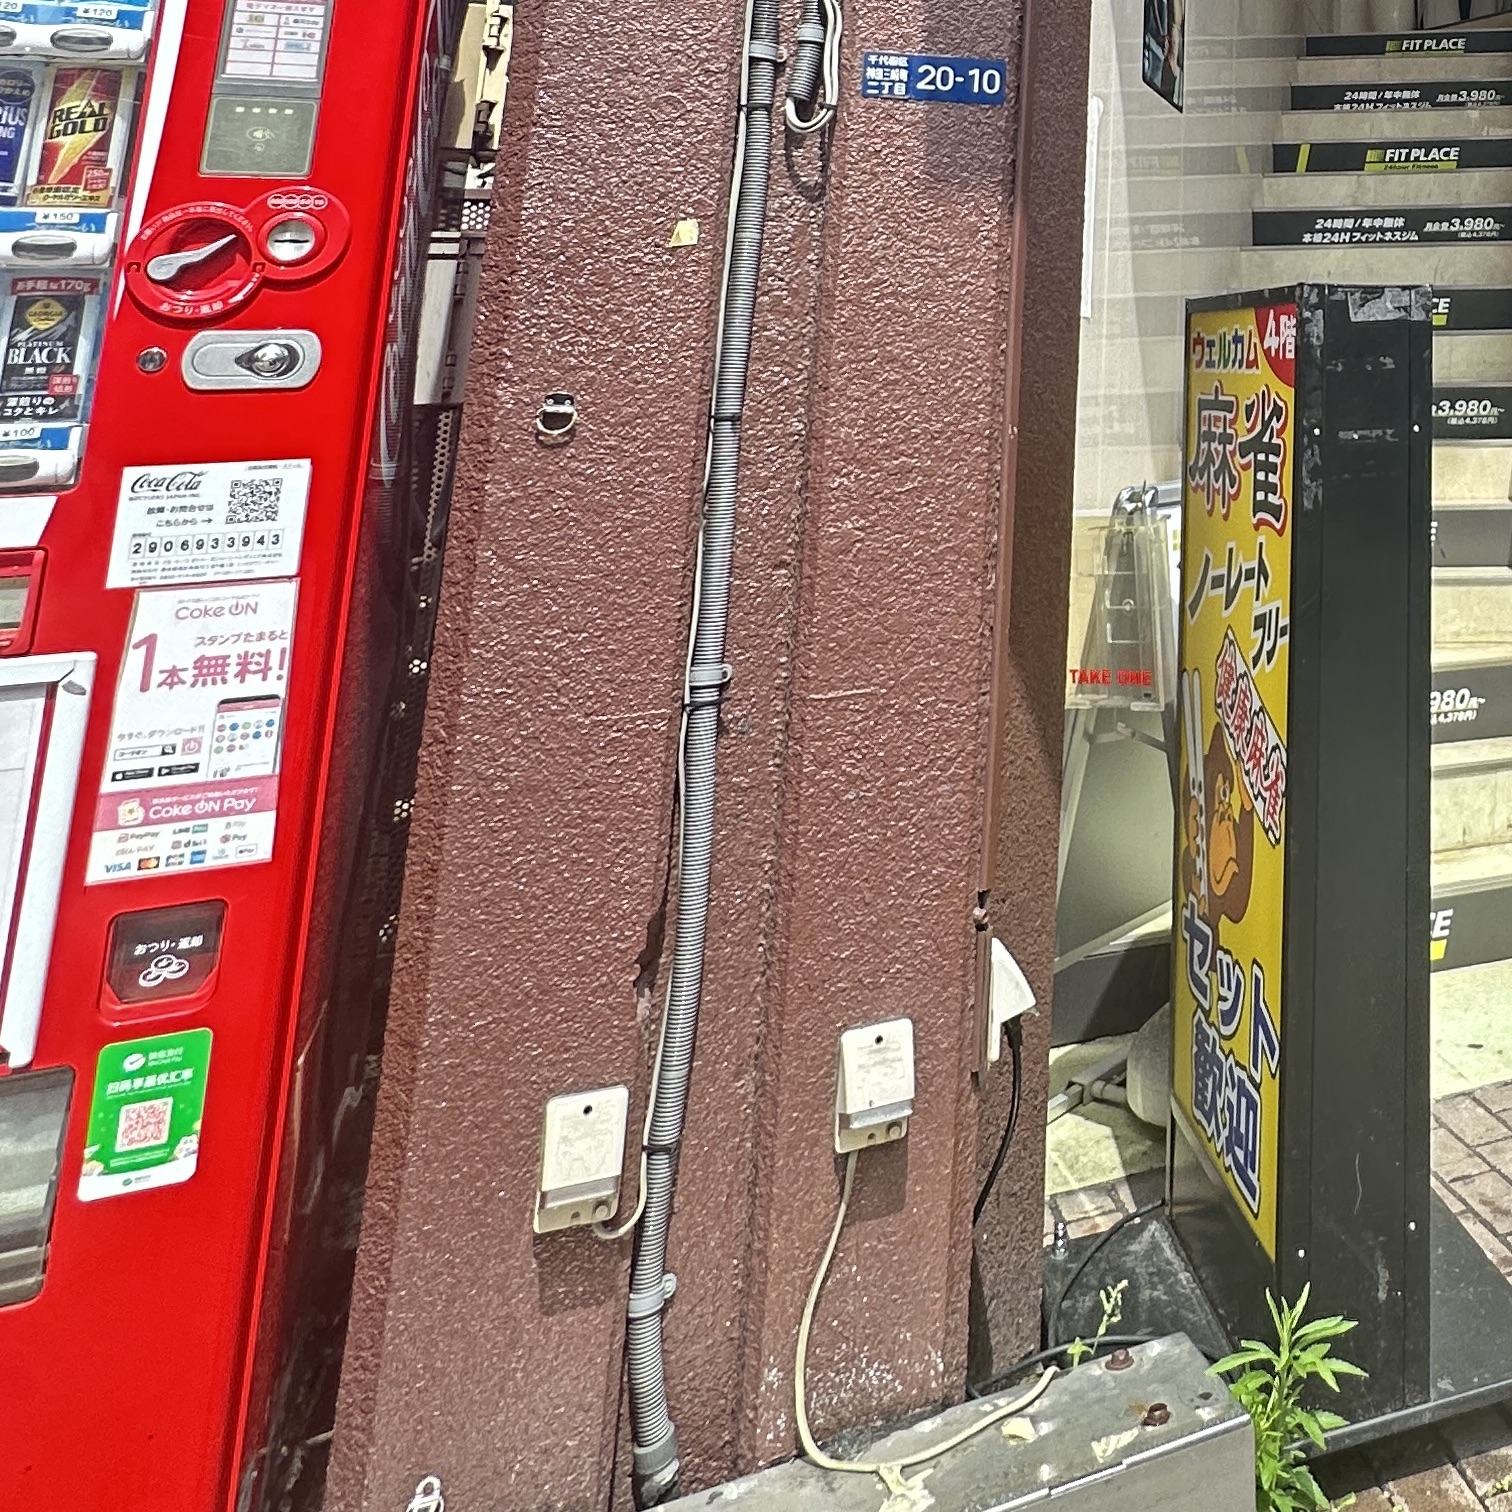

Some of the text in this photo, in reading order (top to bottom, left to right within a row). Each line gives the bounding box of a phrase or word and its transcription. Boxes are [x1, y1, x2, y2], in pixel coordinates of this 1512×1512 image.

[1402, 37, 1467, 51] FIT PLACE
[868, 54, 909, 67] 千代田区
[866, 81, 906, 96] 二丁目
[916, 64, 1001, 95] 20-10
[53, 99, 109, 125] REAL
[49, 116, 109, 139] GOLD
[1385, 147, 1461, 162] FIT PLACE
[1263, 308, 1297, 361] 4階
[7, 347, 73, 366] BLACK
[1191, 325, 1261, 374] ウェルカム
[1189, 381, 1288, 536] 麻雀
[1187, 535, 1271, 624] ノーレート
[175, 600, 259, 620] Coke ON
[194, 629, 290, 648] スタンプたまると
[1249, 602, 1291, 676] フリー
[132, 632, 289, 694] 1本無料!
[1069, 668, 1153, 687] TAKE ONE
[148, 796, 258, 820] Coke ON Pay
[103, 861, 132, 874] VISA
[1181, 892, 1281, 1083] セット
[1191, 1009, 1262, 1219] 歓迎
